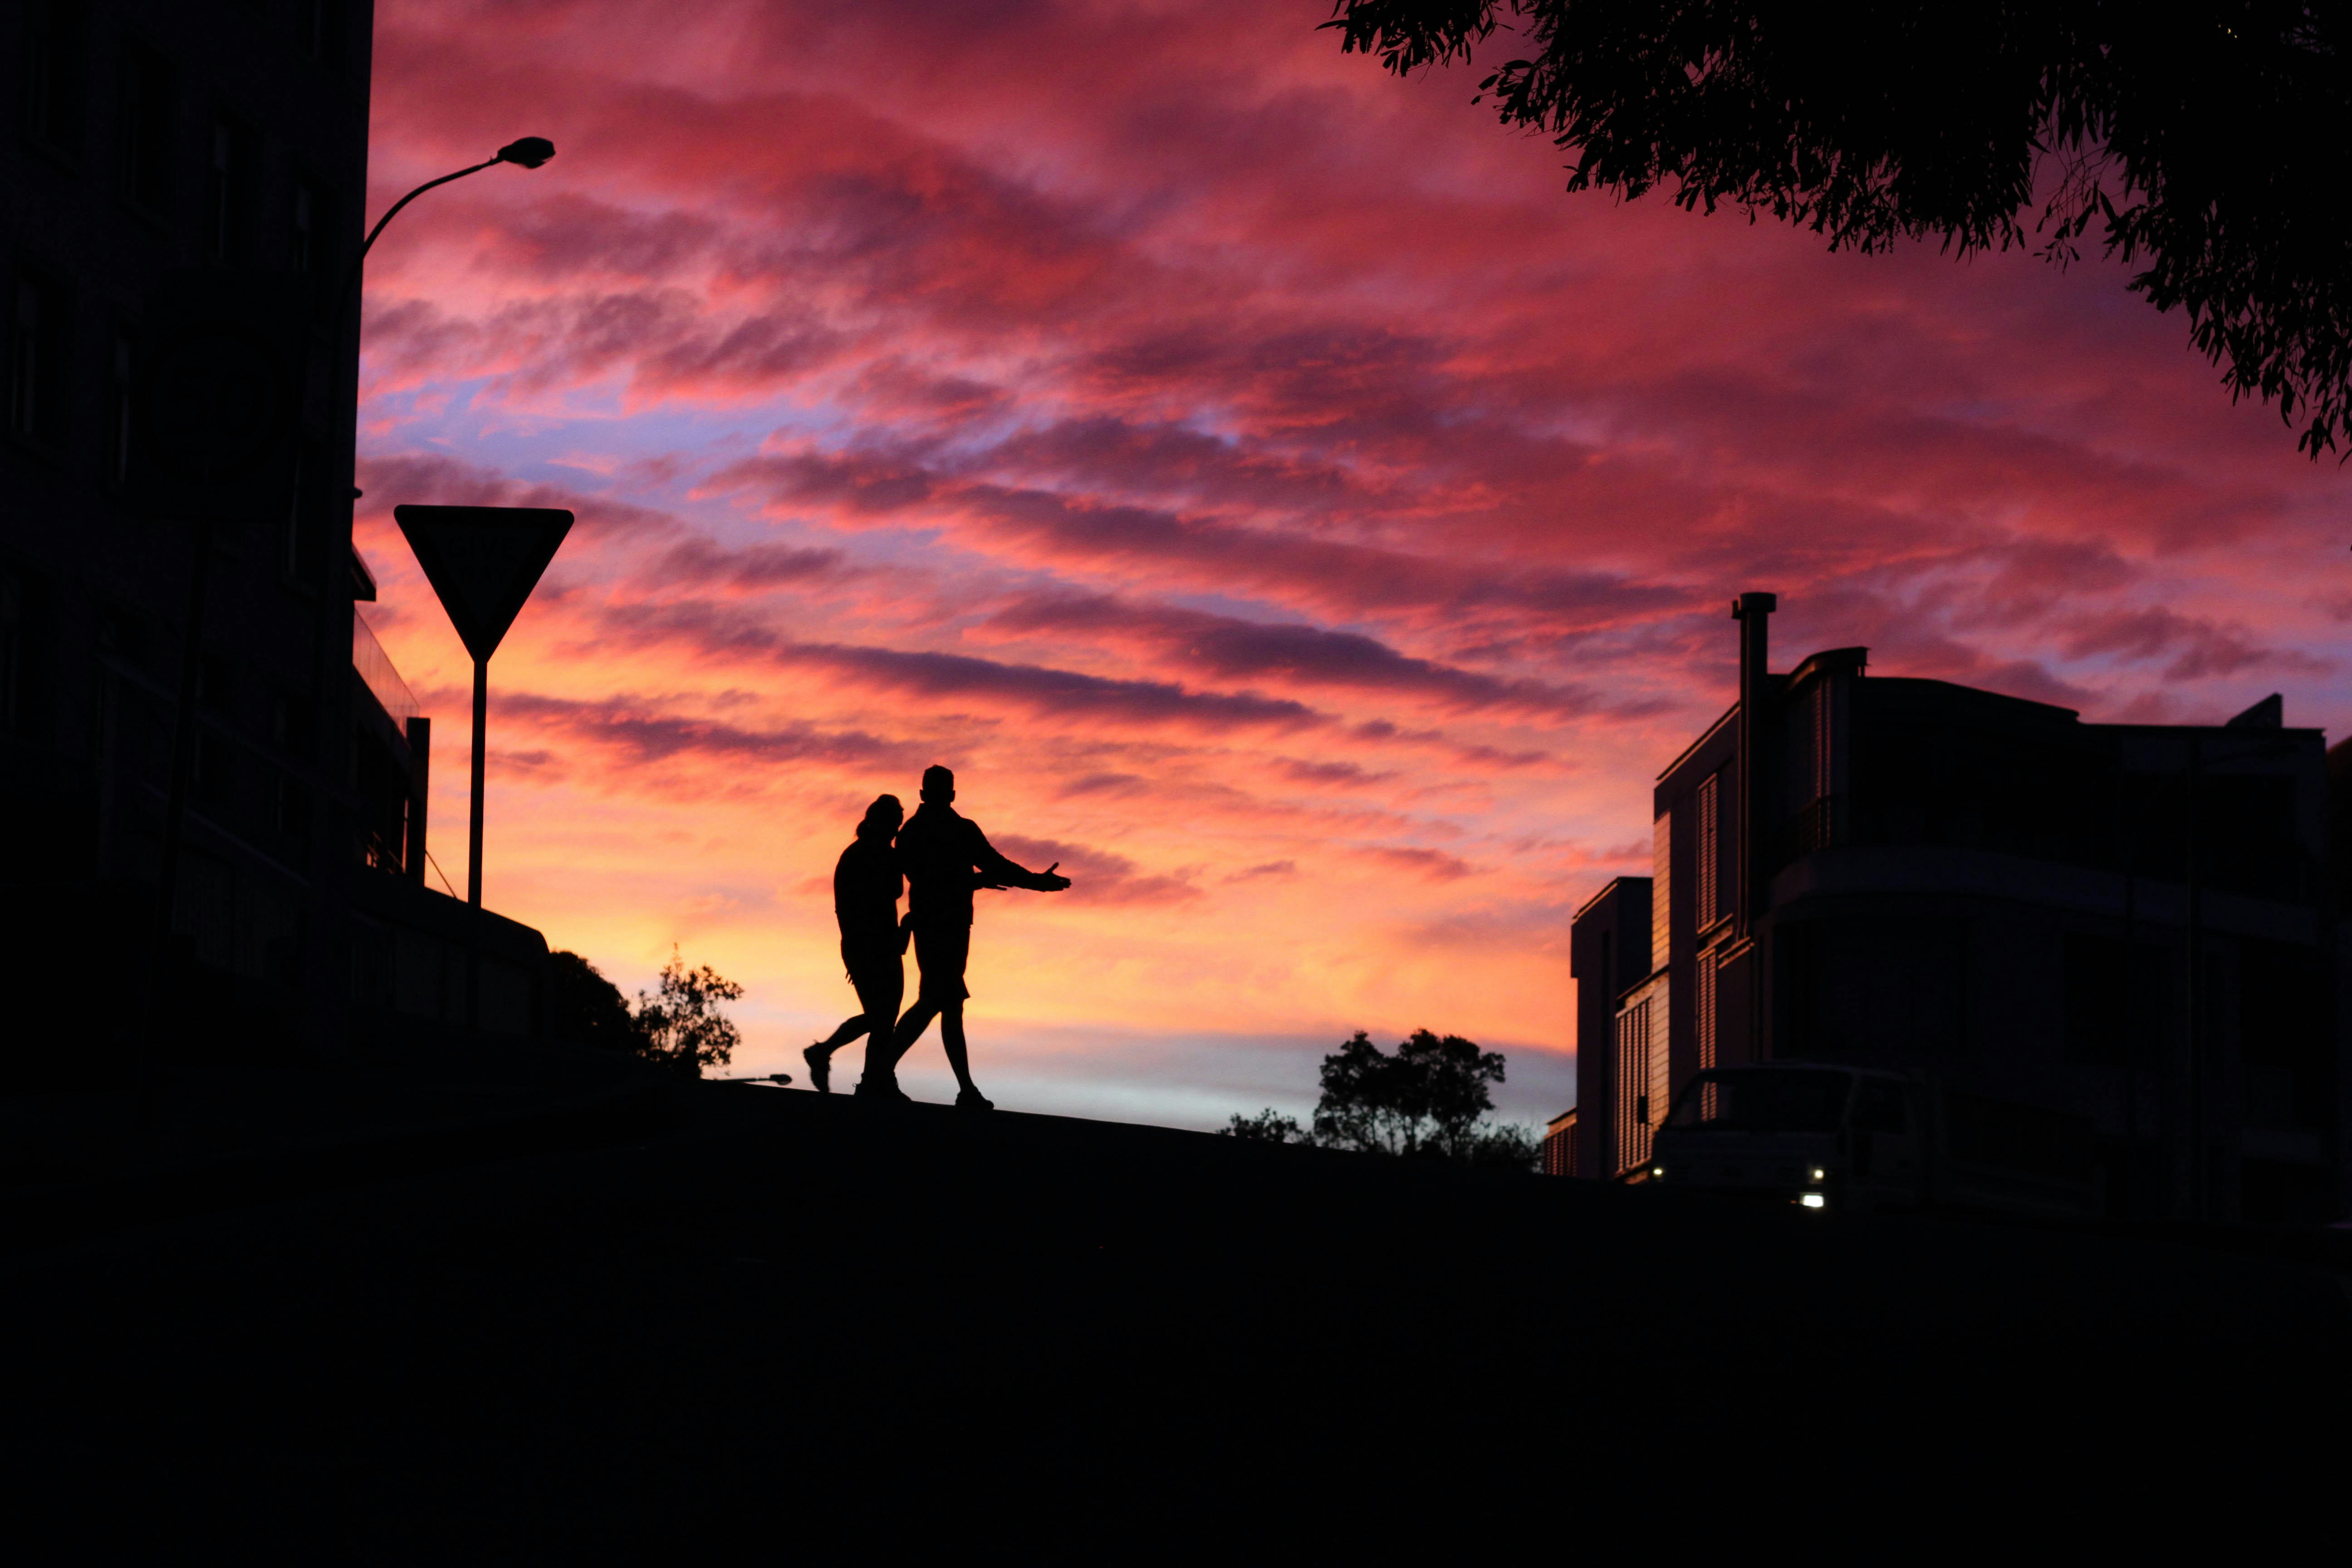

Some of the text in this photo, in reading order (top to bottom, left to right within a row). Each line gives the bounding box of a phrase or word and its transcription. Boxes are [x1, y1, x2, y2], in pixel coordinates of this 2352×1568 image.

[161, 366, 264, 438] 50
[448, 534, 519, 560] GIVE
[459, 566, 508, 585] WAY
